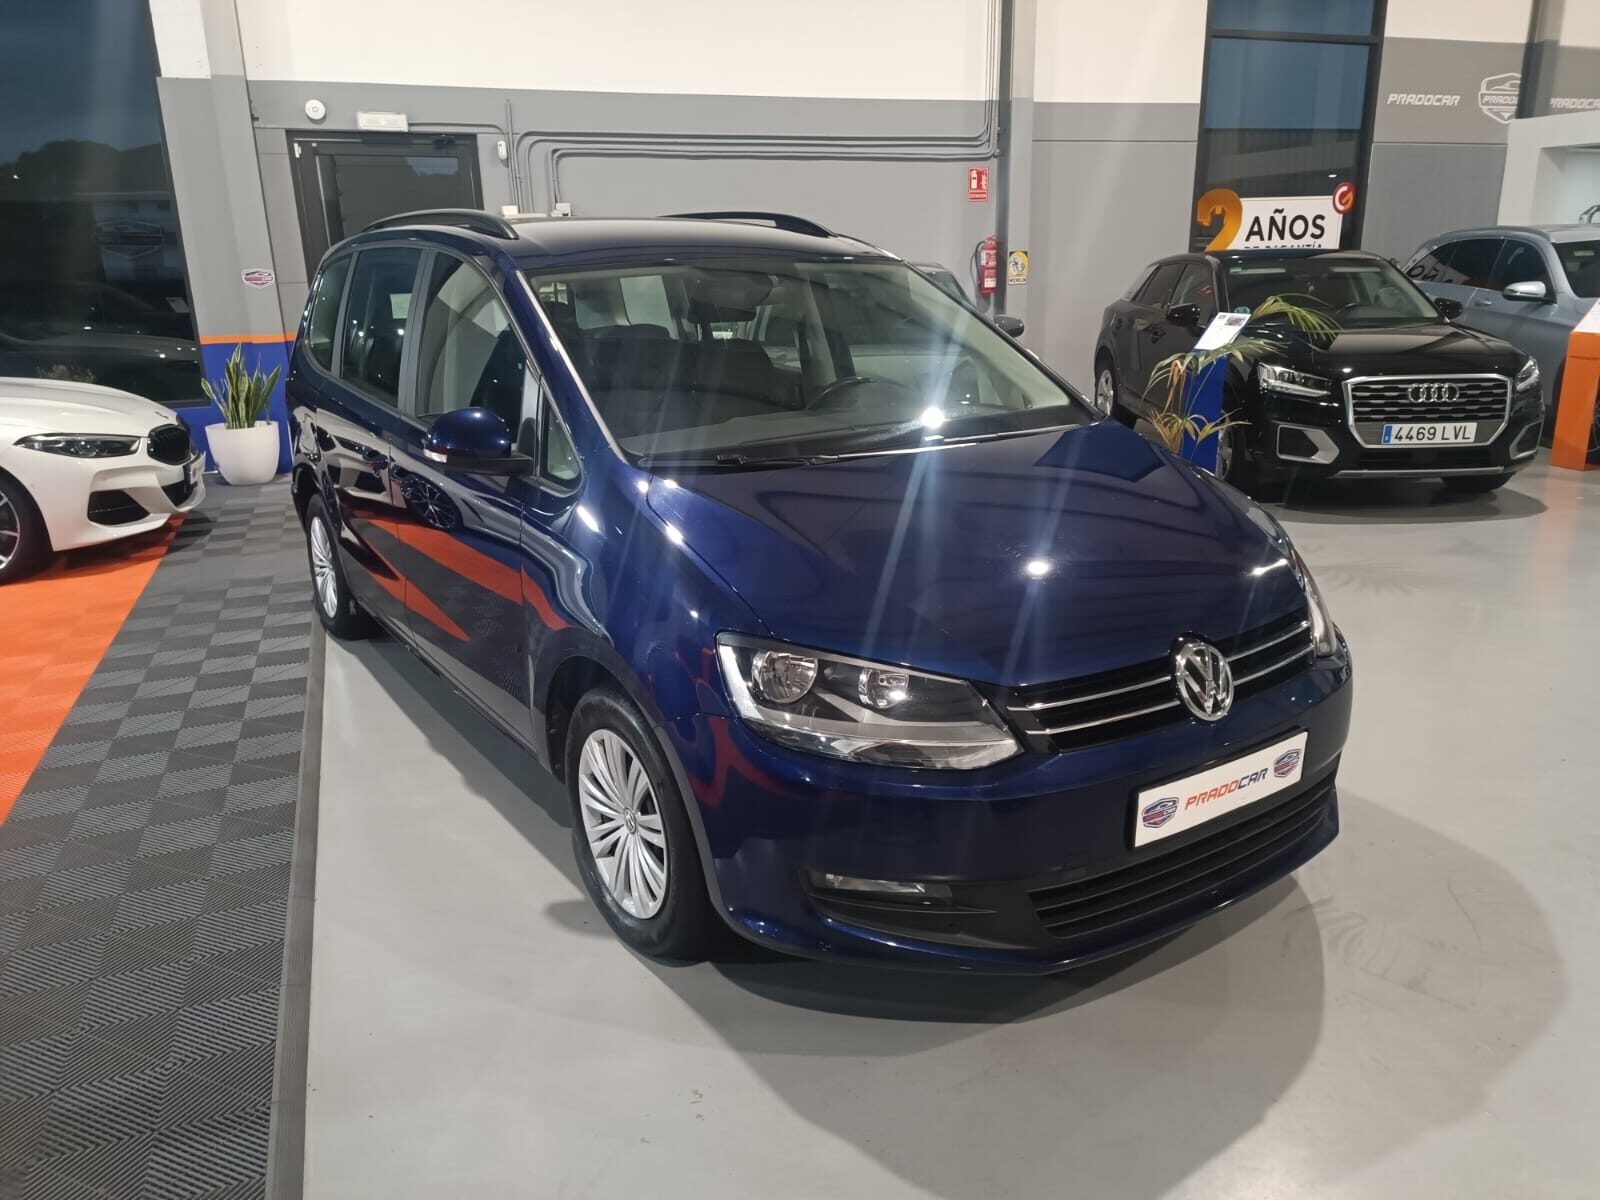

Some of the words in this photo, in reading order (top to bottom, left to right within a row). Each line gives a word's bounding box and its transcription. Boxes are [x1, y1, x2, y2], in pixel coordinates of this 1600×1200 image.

[1387, 93, 1460, 106] PRADOCAR
[1245, 208, 1326, 242] AÑOS
[1394, 426, 1436, 442] 4469
[1441, 425, 1471, 441] LVL
[1185, 767, 1268, 811] PRADOCAR
